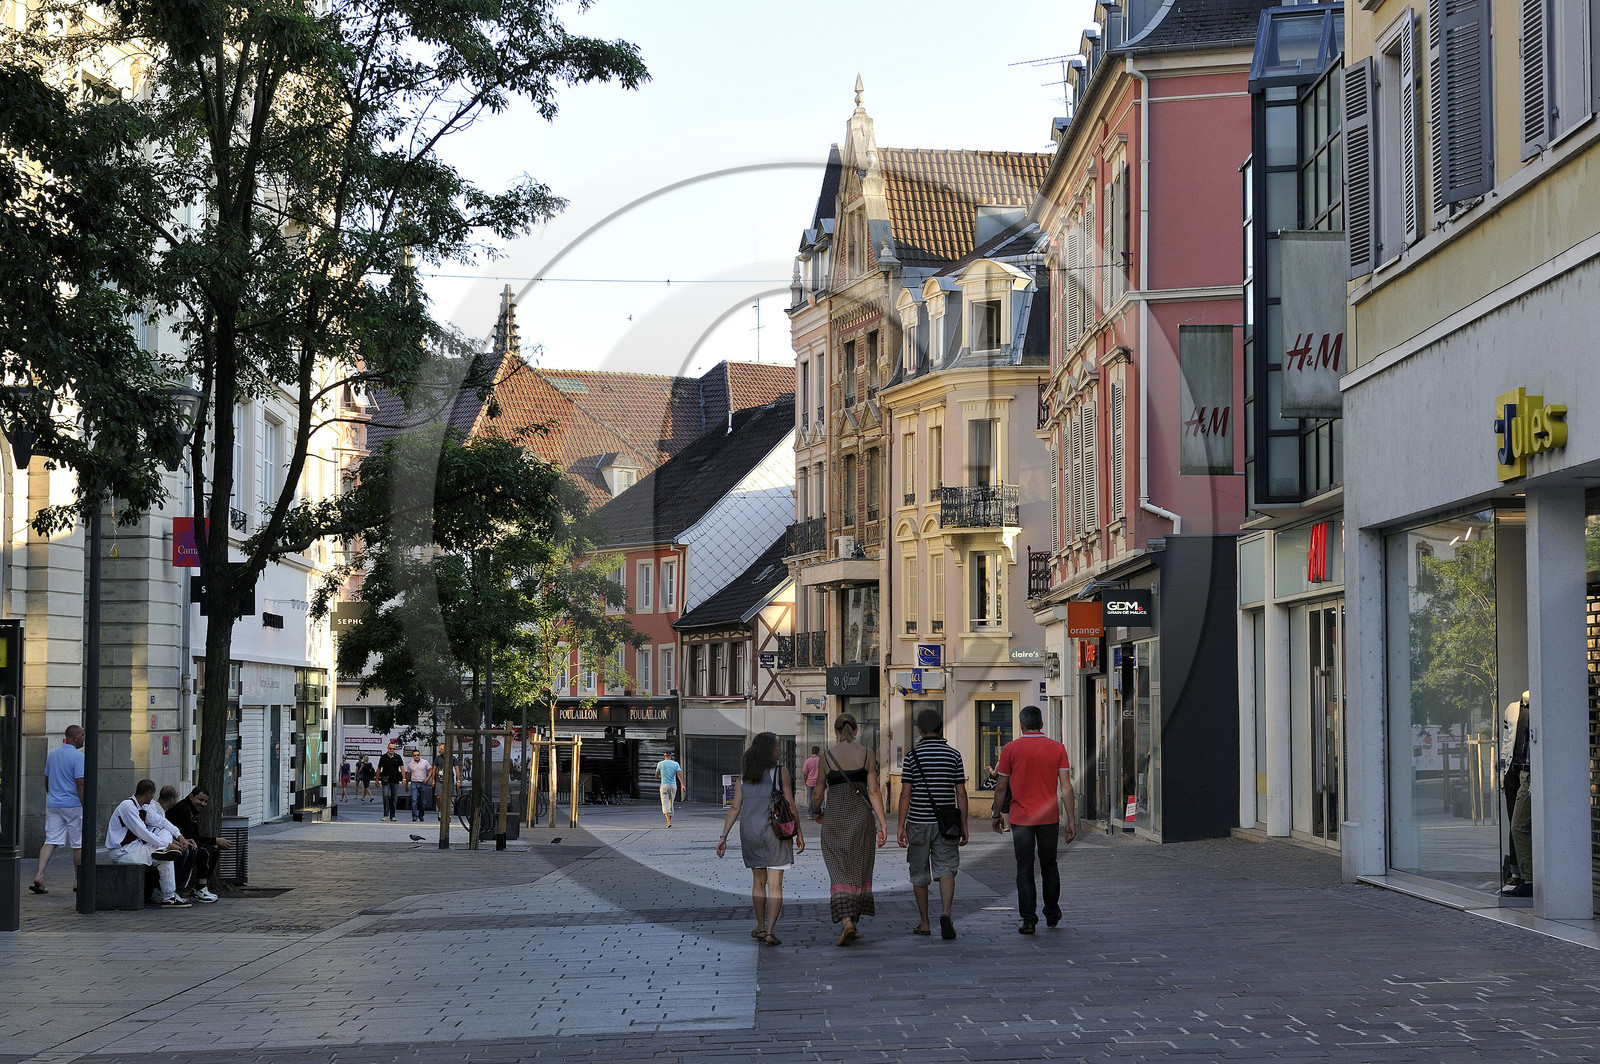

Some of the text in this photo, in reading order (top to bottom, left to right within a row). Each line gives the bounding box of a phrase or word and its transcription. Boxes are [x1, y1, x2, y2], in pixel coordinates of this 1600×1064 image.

[1286, 332, 1344, 372] H&M
[1184, 406, 1230, 438] H&M
[1494, 394, 1567, 466] Jules
[177, 544, 199, 555] Cama
[1106, 601, 1139, 611] GDM
[1070, 627, 1100, 636] orange
[1011, 650, 1039, 658] claire's
[559, 709, 598, 720] POULAILLON
[630, 709, 667, 720] POULAILLON
